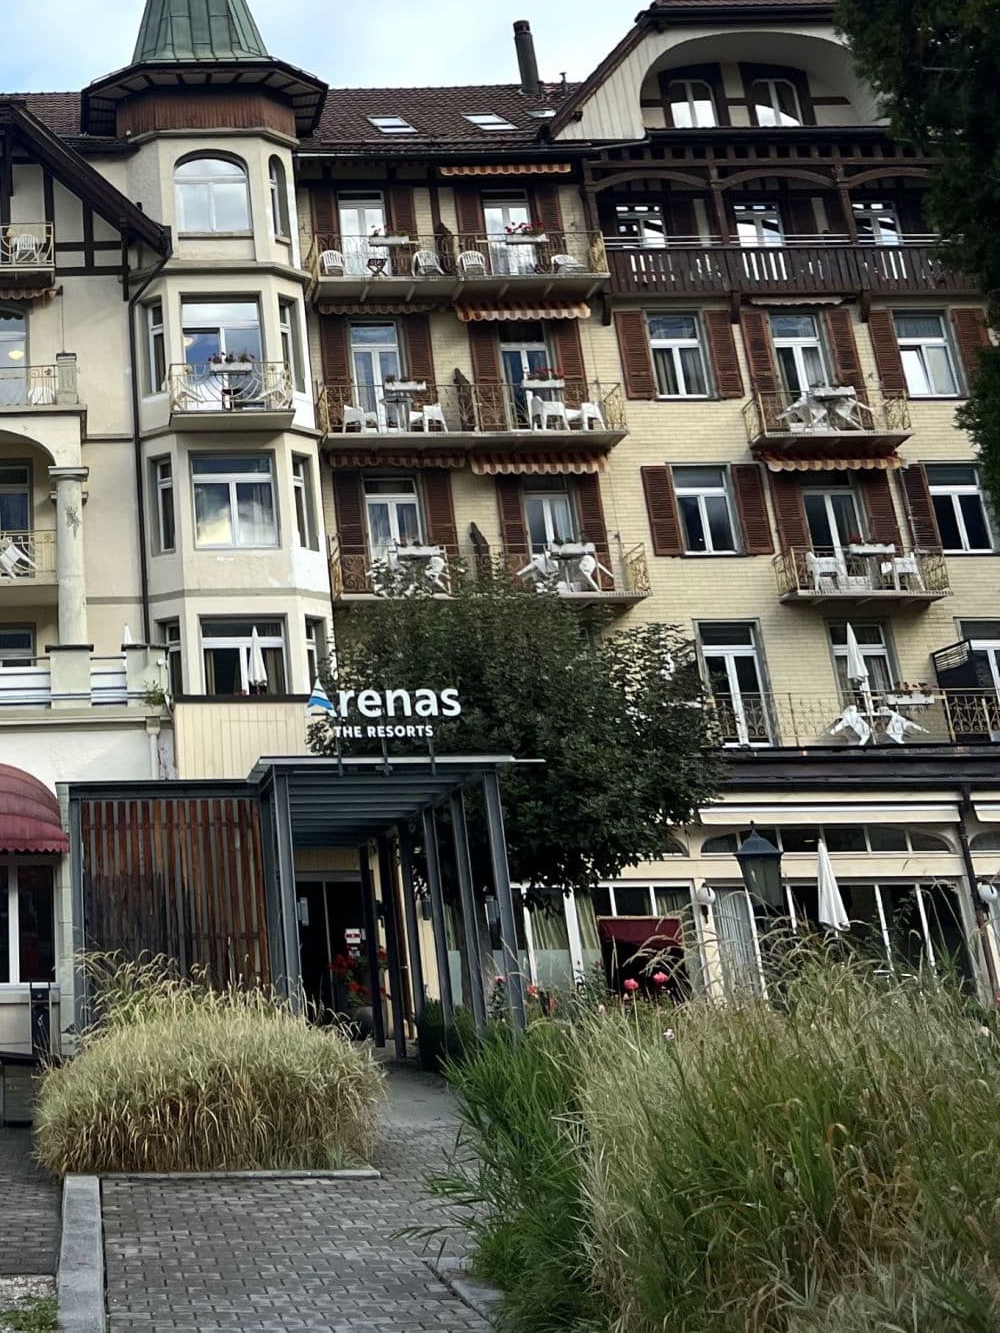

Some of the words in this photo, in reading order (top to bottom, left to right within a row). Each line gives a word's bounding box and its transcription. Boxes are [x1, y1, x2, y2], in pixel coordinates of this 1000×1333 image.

[307, 677, 461, 717] Arenas
[334, 725, 362, 738] THE
[367, 725, 433, 738] RESORTS
